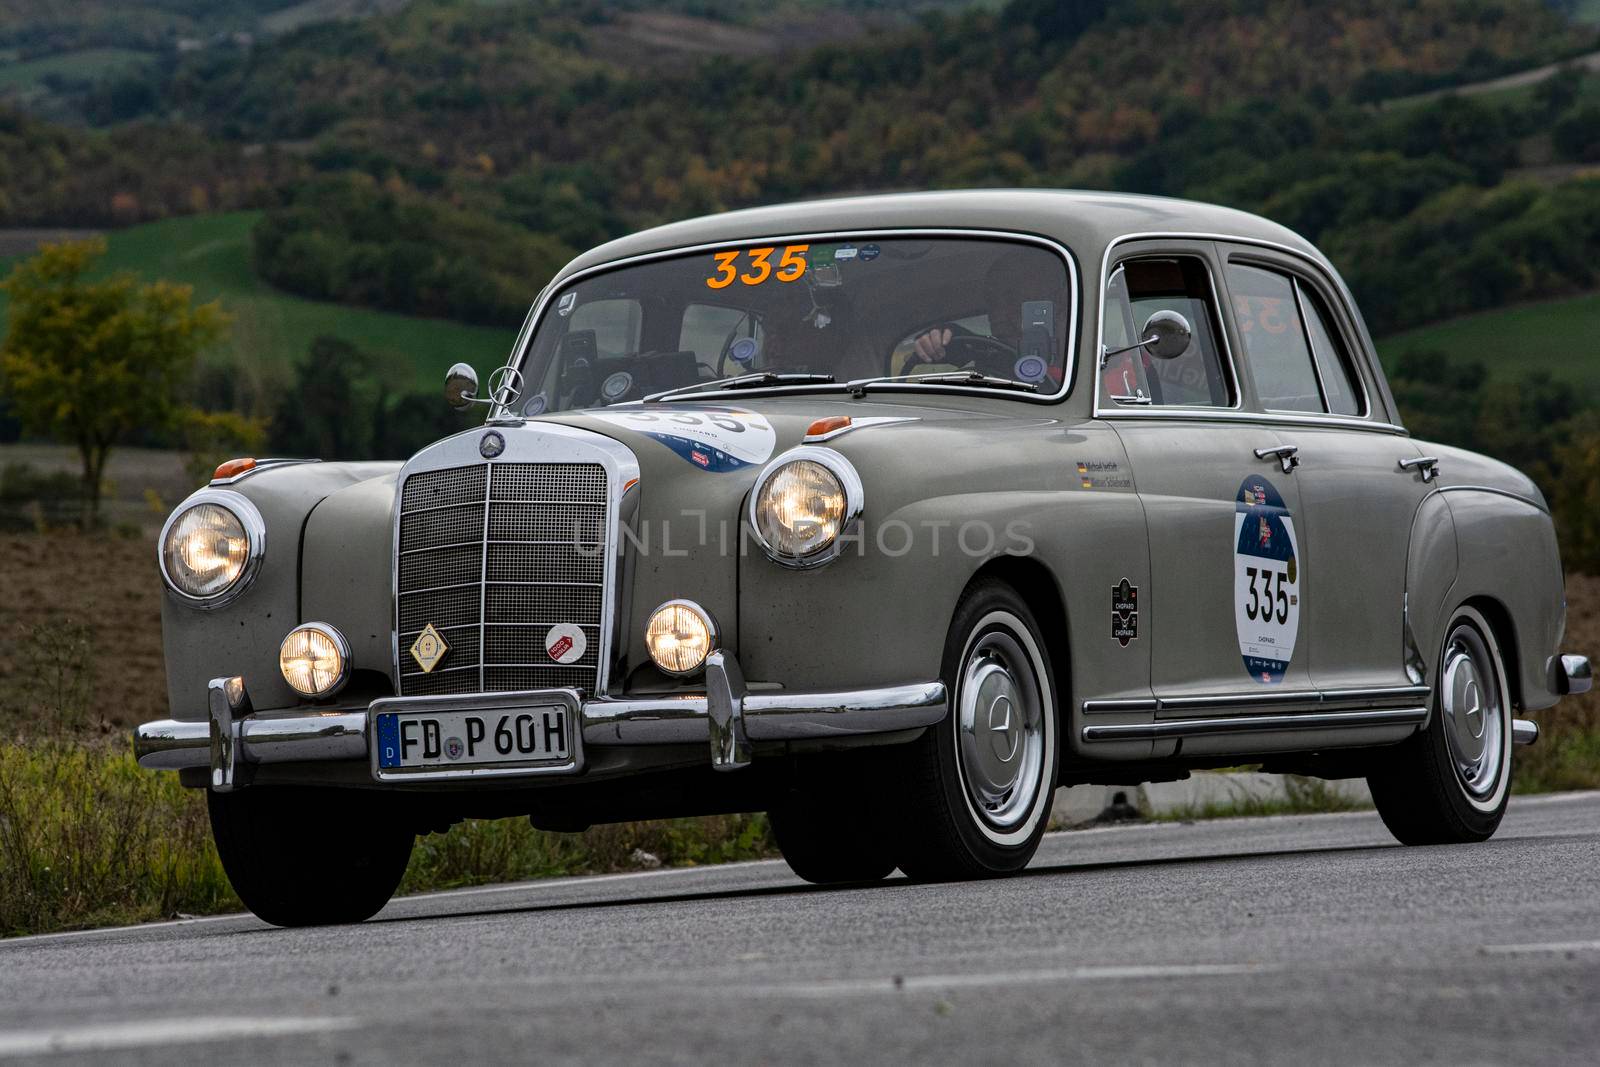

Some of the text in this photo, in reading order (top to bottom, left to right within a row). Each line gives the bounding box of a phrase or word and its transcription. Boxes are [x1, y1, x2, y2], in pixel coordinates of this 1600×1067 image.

[706, 244, 810, 289] 335
[1115, 602, 1135, 610] CHOPARD
[1246, 566, 1288, 625] 335
[1115, 629, 1134, 637] CHOPARD
[400, 712, 566, 760] FD P 60H
[386, 747, 395, 759] D
